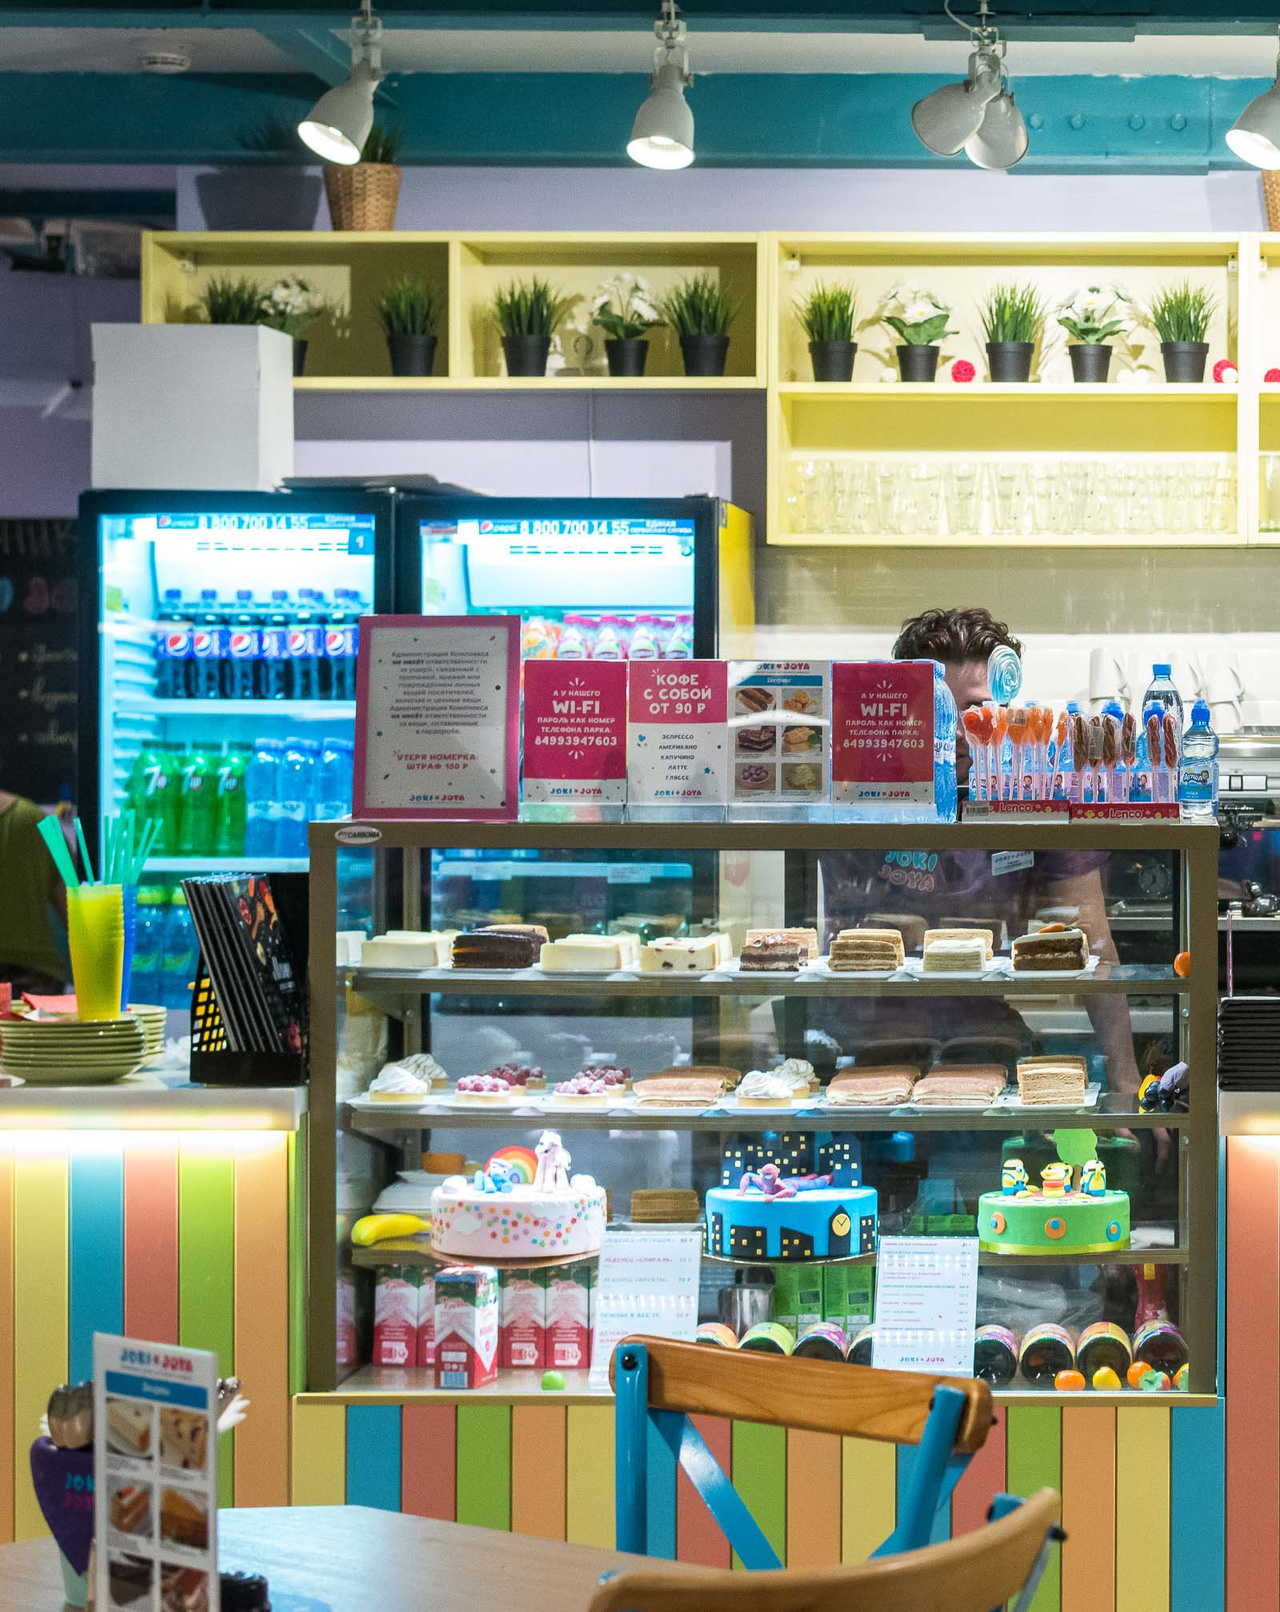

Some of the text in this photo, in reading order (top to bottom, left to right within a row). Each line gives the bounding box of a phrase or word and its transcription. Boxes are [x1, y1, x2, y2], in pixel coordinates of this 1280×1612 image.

[211, 515, 238, 529] 800
[240, 515, 268, 529] 700
[520, 520, 530, 534] 8
[533, 520, 560, 534] 800
[562, 520, 589, 534] 700
[592, 520, 608, 534] 14
[611, 520, 630, 534] 55
[355, 535, 364, 549] 1
[784, 662, 810, 670] JOYA
[656, 674, 699, 686] КОФЕ
[643, 685, 712, 700] С СОБОЙ
[552, 700, 600, 714] WI-FI
[649, 702, 669, 715] ОТ
[675, 702, 692, 715] 90
[860, 703, 908, 717] WI-FI
[534, 736, 617, 746] 84993947603
[843, 739, 925, 749] 84993947603
[409, 794, 434, 802] JOKI
[858, 790, 881, 798] JOKI
[998, 802, 1034, 814] Lenco
[1109, 808, 1144, 819] Lenco
[885, 850, 939, 872] JOKI
[878, 865, 935, 892] JOYA
